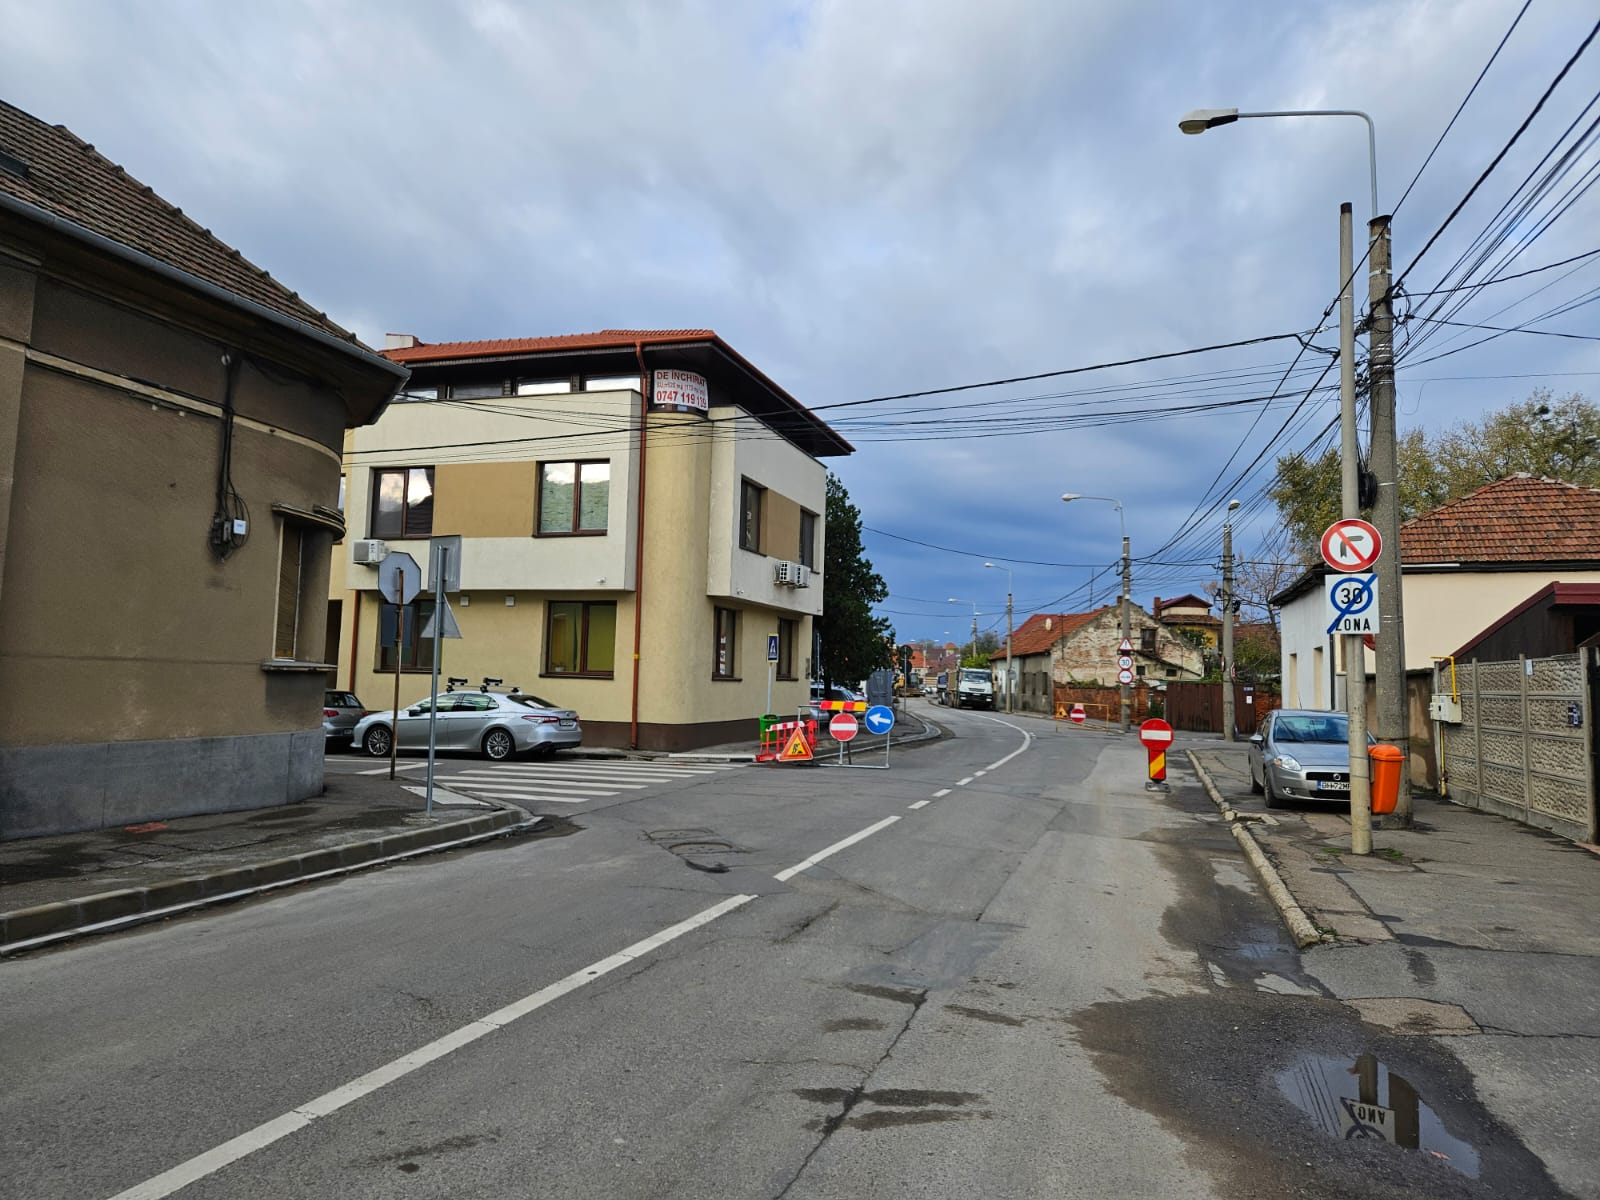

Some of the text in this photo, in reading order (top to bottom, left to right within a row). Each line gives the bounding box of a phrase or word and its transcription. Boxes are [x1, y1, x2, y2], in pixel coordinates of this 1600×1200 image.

[656, 371, 669, 380] DE
[656, 391, 678, 402] 0747
[681, 392, 695, 404] 119
[1341, 588, 1362, 604] 30
